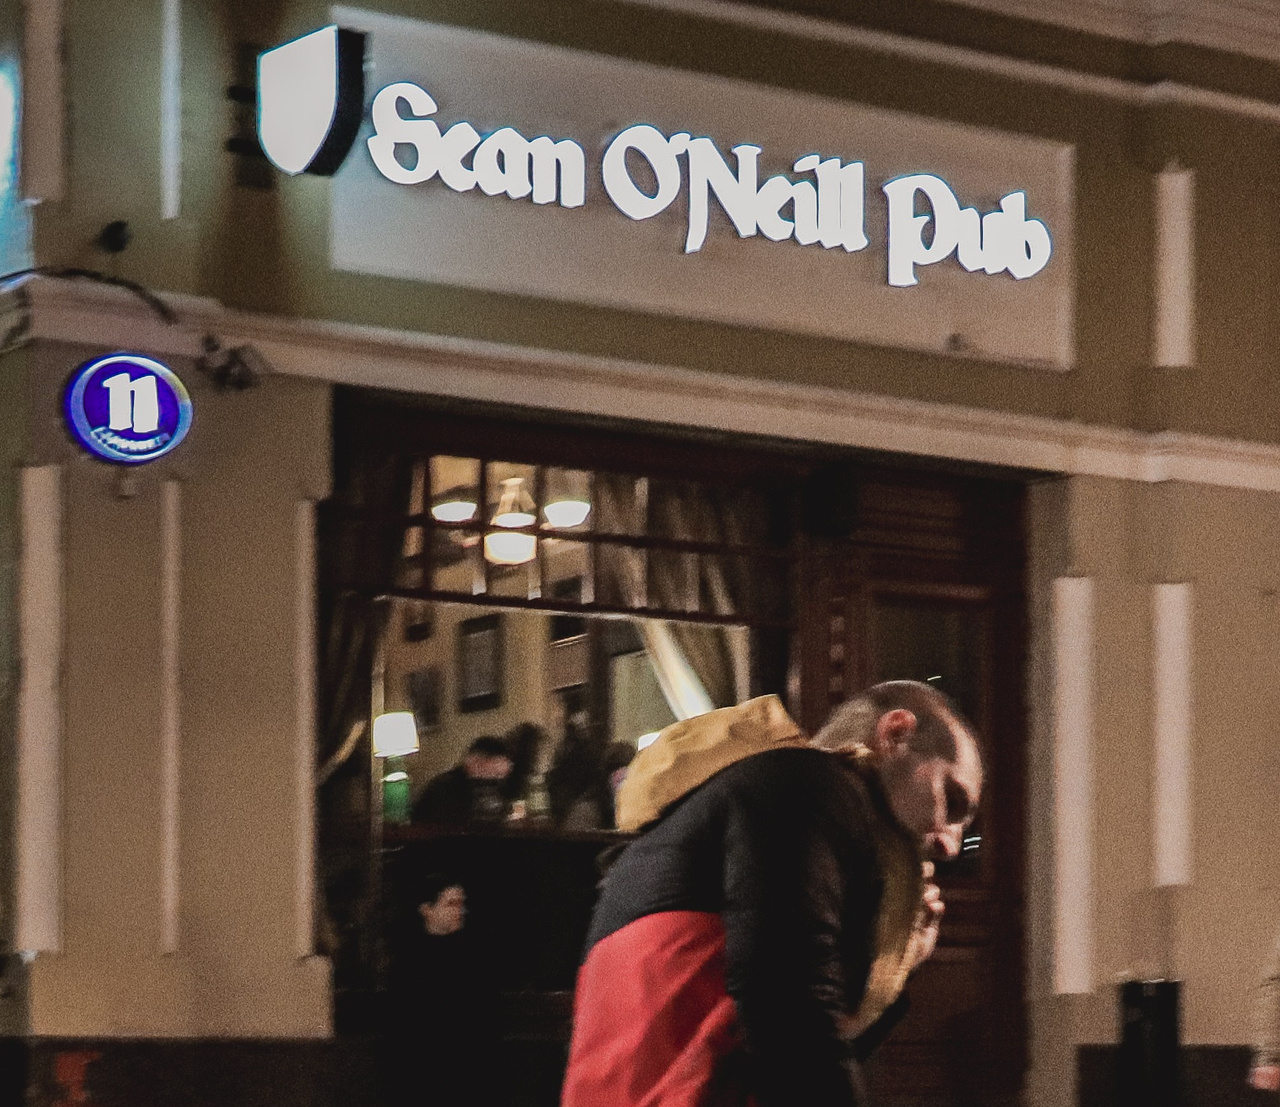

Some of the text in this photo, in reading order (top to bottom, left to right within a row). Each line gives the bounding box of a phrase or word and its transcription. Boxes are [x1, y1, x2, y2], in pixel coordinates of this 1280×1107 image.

[367, 82, 1053, 287] Sean O'Neill Pub
